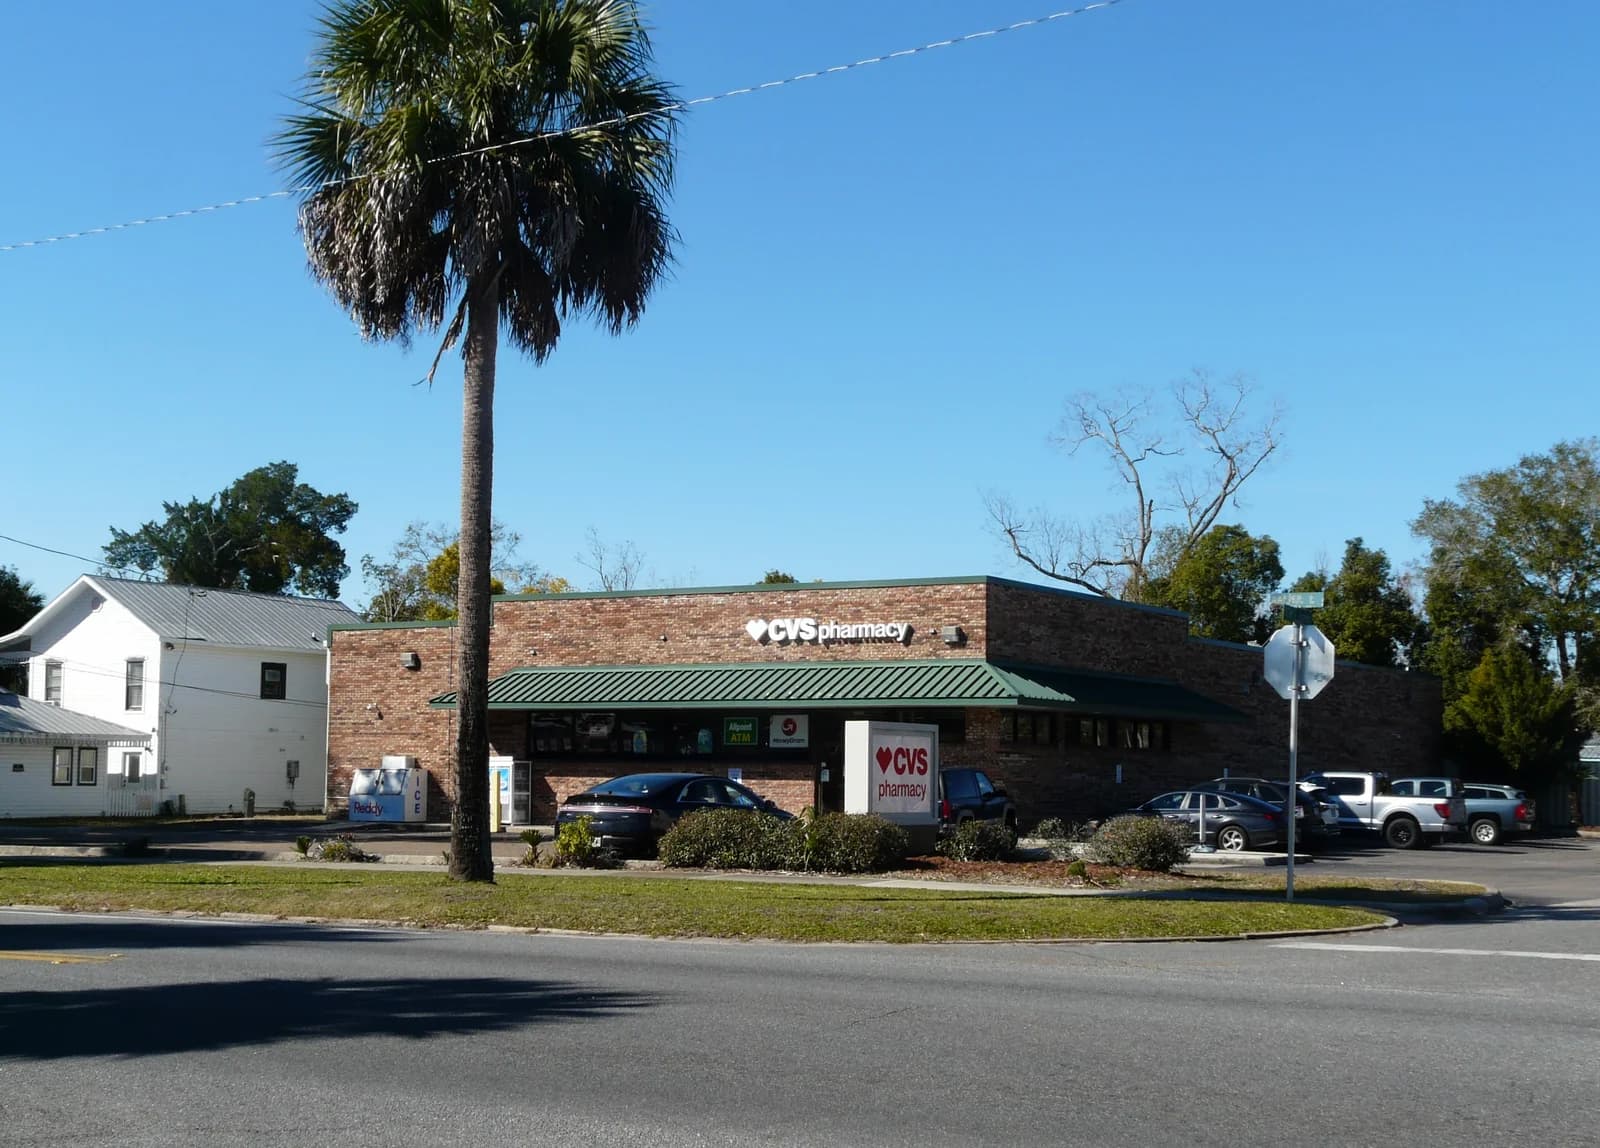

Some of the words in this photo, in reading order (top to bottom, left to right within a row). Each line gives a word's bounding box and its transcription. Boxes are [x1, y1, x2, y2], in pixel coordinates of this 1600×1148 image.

[768, 618, 818, 641] CVS
[818, 620, 908, 643] pharmacy
[730, 733, 751, 743] ATM
[893, 746, 928, 776] CVS
[878, 779, 927, 801] pharmacy
[353, 801, 384, 817] Reddy
